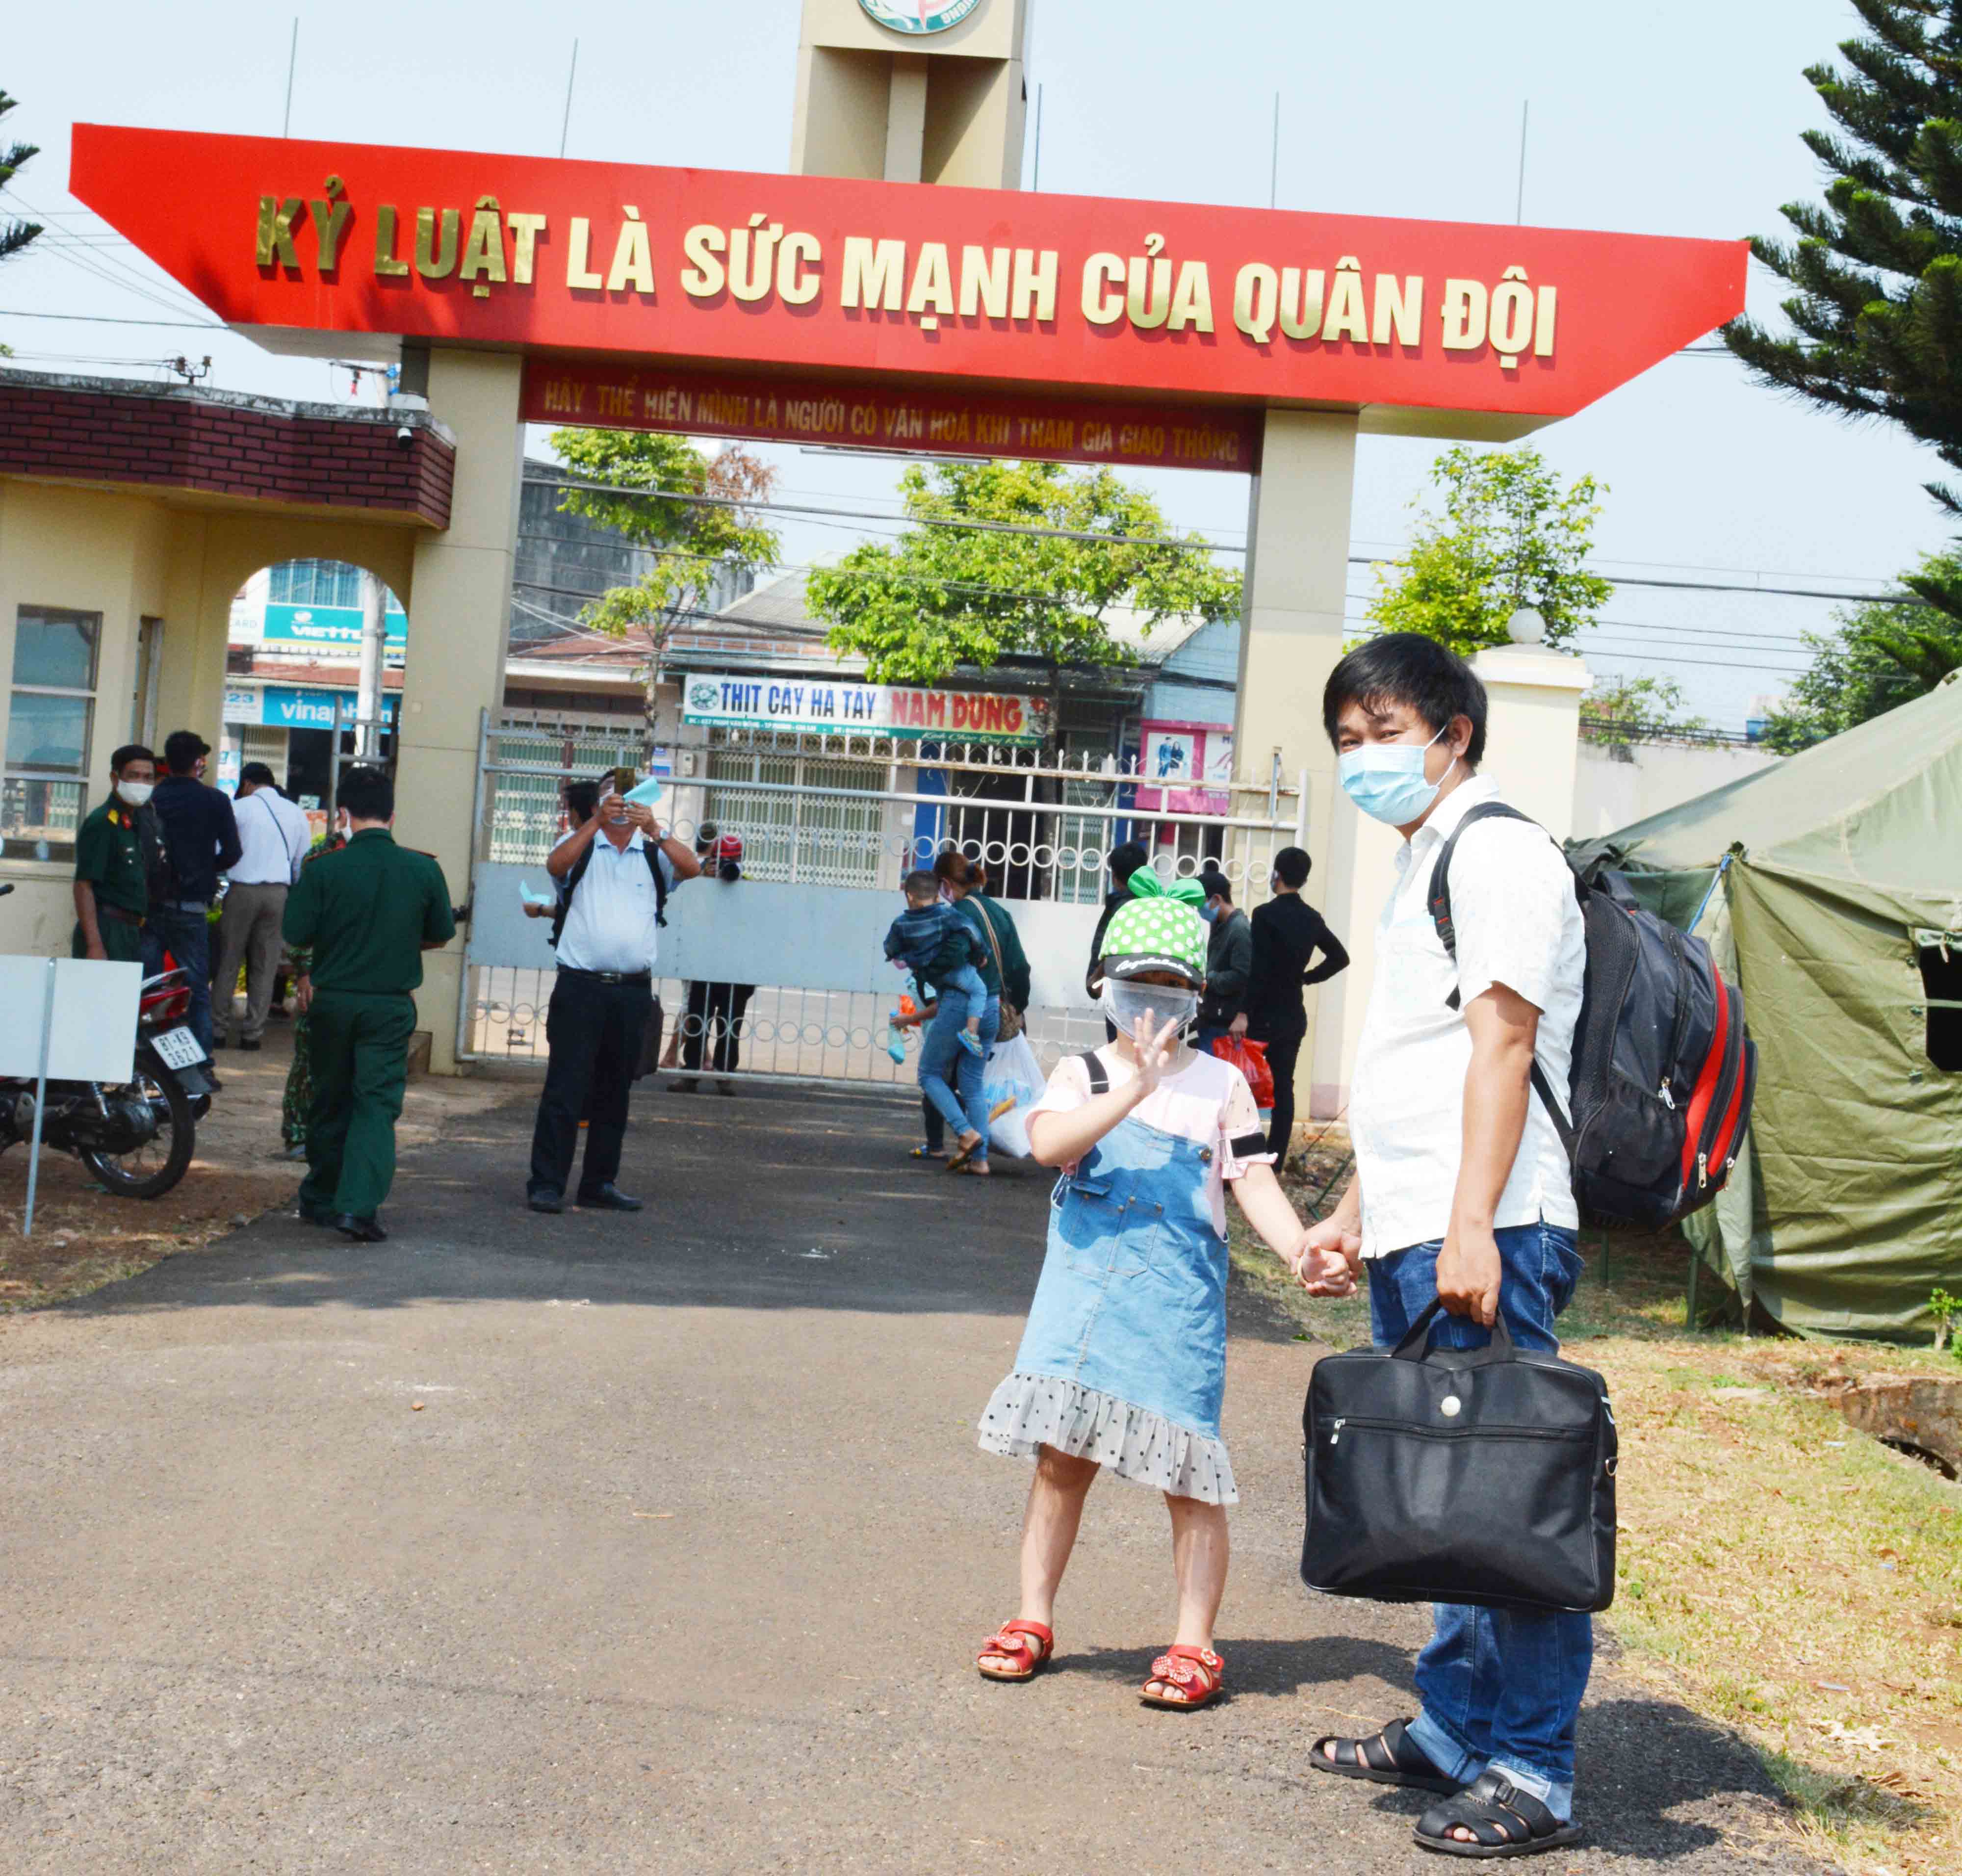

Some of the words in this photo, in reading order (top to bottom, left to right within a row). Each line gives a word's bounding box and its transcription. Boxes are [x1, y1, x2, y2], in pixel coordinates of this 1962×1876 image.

[256, 175, 353, 270] KỶ
[374, 196, 546, 297] LUẬT
[567, 205, 655, 293] LÀ
[681, 213, 821, 304] SỨC
[840, 235, 1058, 331] MẠNH
[1081, 234, 1215, 333] CỦA
[1232, 256, 1423, 346] QUÂN
[1441, 264, 1557, 369] ĐỘI
[643, 386, 692, 427] HIỆN
[696, 388, 749, 427] MÌNH
[753, 391, 779, 428] LÀ
[785, 395, 845, 433] NGƯỜI
[851, 398, 876, 436] CÓ
[884, 405, 922, 440] VĂN
[975, 413, 1010, 445] KHI
[1019, 417, 1074, 450] THAM
[1081, 422, 1112, 452] GIA
[1120, 425, 1164, 456] GIAO
[1172, 424, 1238, 462] THÔNG
[721, 682, 762, 719] THỊT
[810, 683, 835, 717] HÀ
[843, 685, 877, 720] TÂY
[891, 691, 945, 727] NAM
